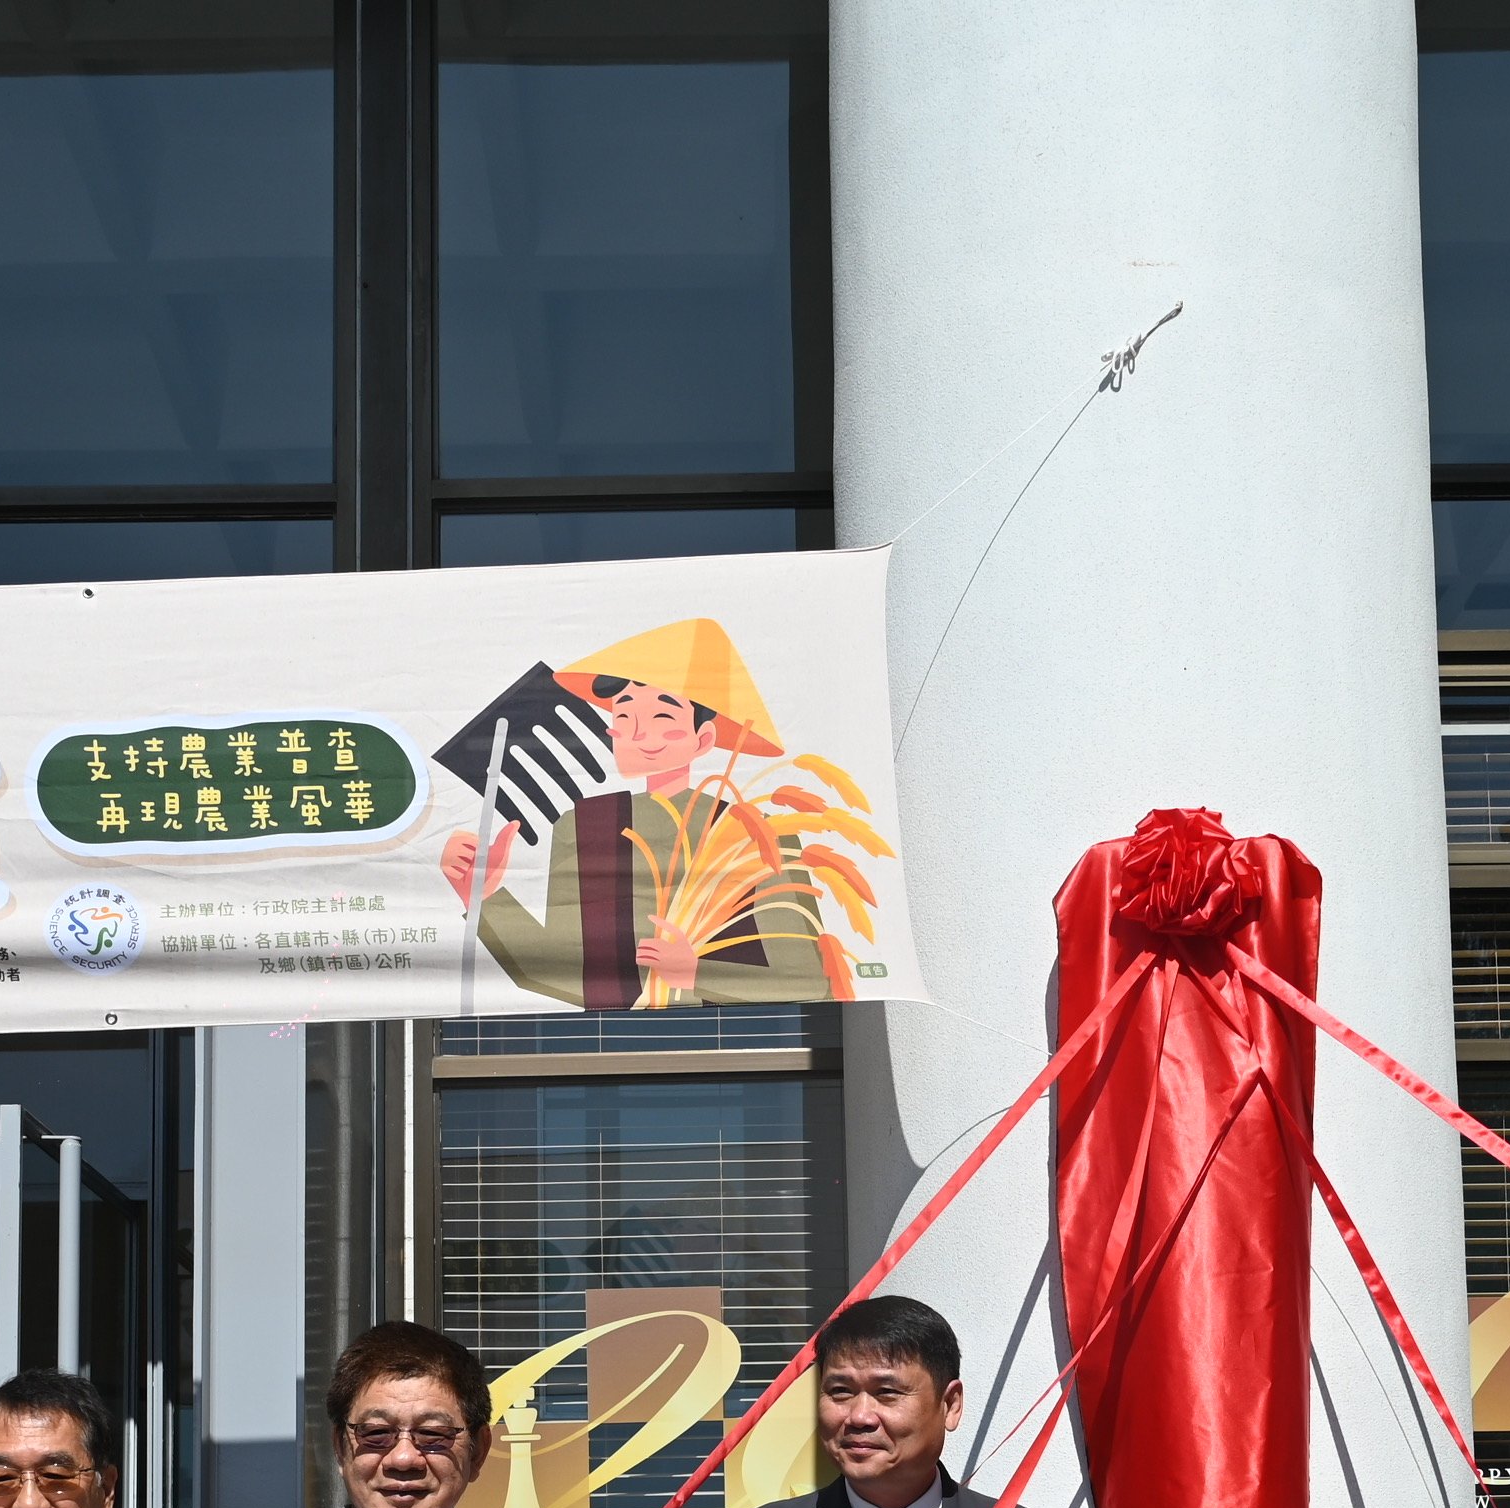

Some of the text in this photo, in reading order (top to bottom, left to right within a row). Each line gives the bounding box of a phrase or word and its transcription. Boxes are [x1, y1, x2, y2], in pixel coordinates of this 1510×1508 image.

[83, 727, 360, 782] 支持農業普查
[96, 779, 375, 834] 再現農業風華
[64, 888, 126, 906] 統計調查
[49, 905, 140, 970] SCIENCE SECURITY SERVICE
[859, 965, 883, 976] 廣告
